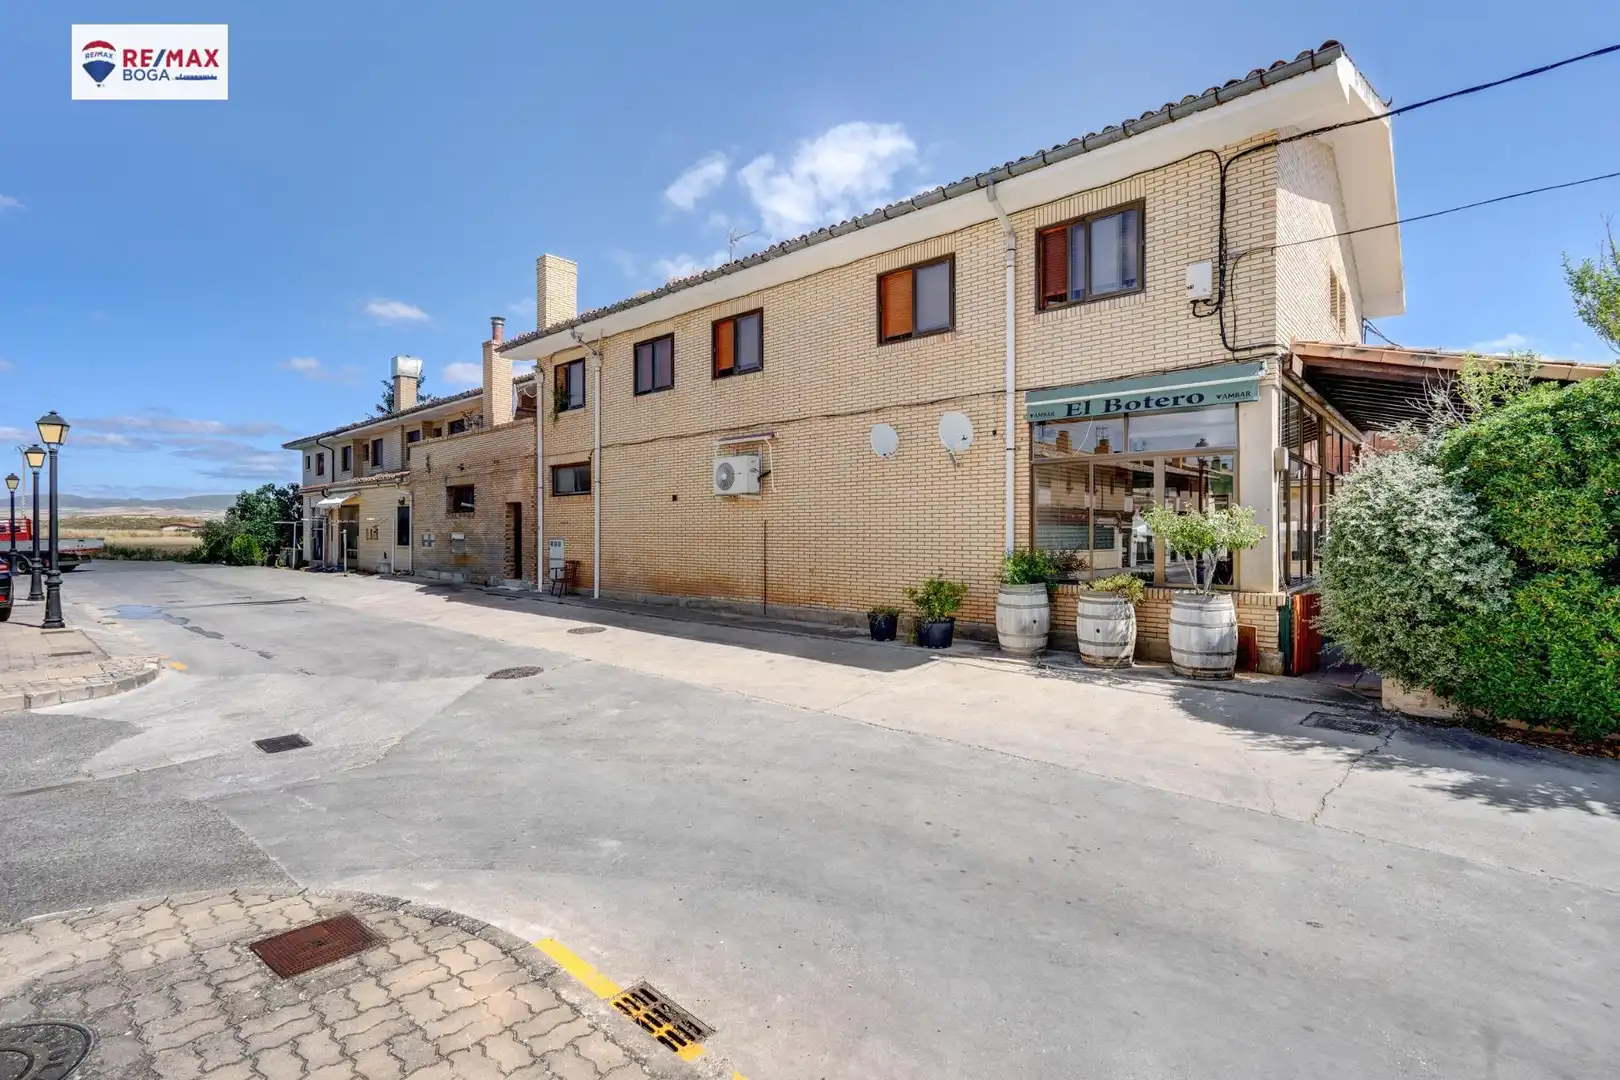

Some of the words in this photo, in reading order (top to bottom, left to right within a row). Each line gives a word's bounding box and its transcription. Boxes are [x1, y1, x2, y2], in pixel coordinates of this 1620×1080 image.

[1220, 390, 1252, 401] AMBAR
[1064, 399, 1091, 417] El
[1102, 392, 1205, 414] Botero
[1034, 411, 1056, 419] AMBAR
